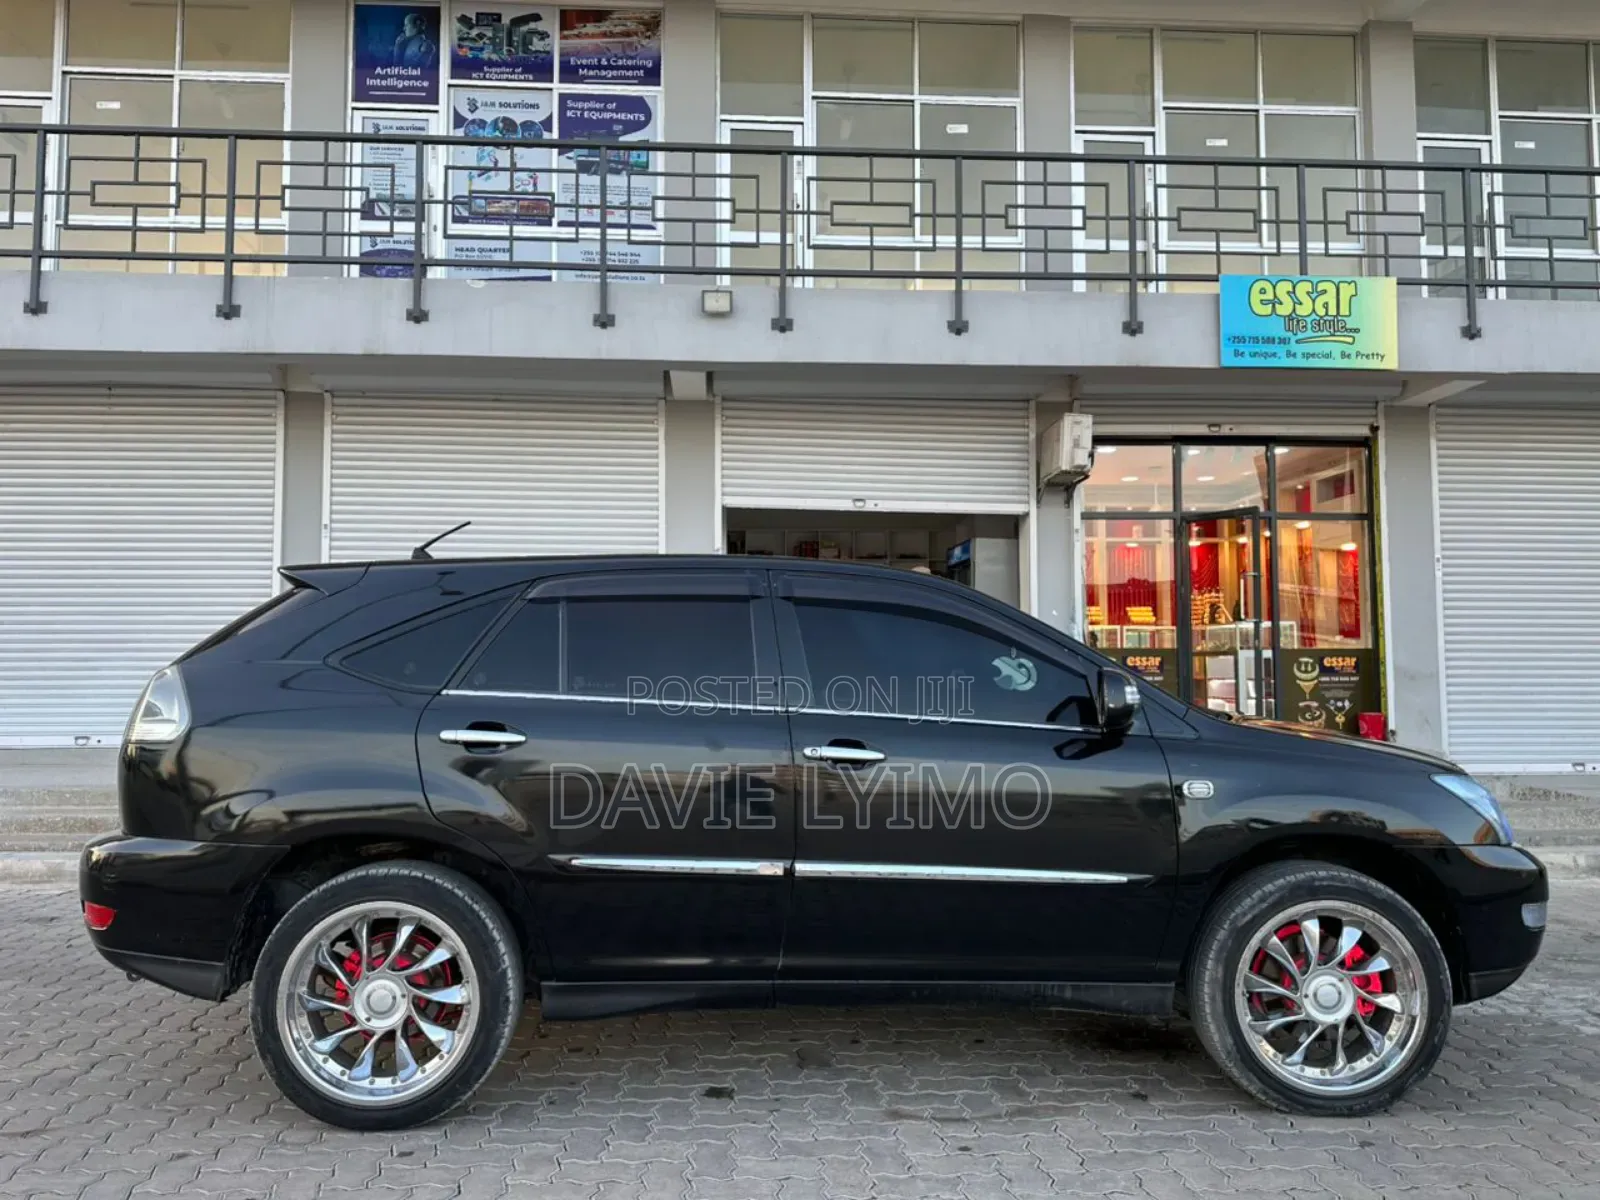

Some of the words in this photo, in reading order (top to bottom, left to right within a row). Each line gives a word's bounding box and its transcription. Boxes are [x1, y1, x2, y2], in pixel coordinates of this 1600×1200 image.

[570, 57, 598, 66] Event
[600, 58, 608, 66] &
[610, 57, 653, 68] Catering
[375, 66, 421, 76] Artificial
[483, 66, 513, 74] Supplier
[579, 68, 645, 77] Management
[485, 73, 534, 81] EQUIPMENTS
[366, 78, 430, 89] Intelligence
[566, 100, 605, 109] Supplier
[566, 110, 581, 118] ICT
[584, 111, 646, 121] EQUIPMENTS
[1248, 279, 1358, 317] essar
[1284, 315, 1308, 336] life
[1227, 336, 1247, 345] +255
[1248, 336, 1260, 345] 715
[1233, 349, 1246, 358] Be
[1248, 350, 1282, 361] unique,
[1285, 350, 1297, 359] Be
[1300, 350, 1335, 361] special,
[1340, 351, 1352, 360] Be
[1355, 351, 1386, 362] Pretty
[1126, 656, 1162, 667] essar
[1323, 656, 1357, 668] essar
